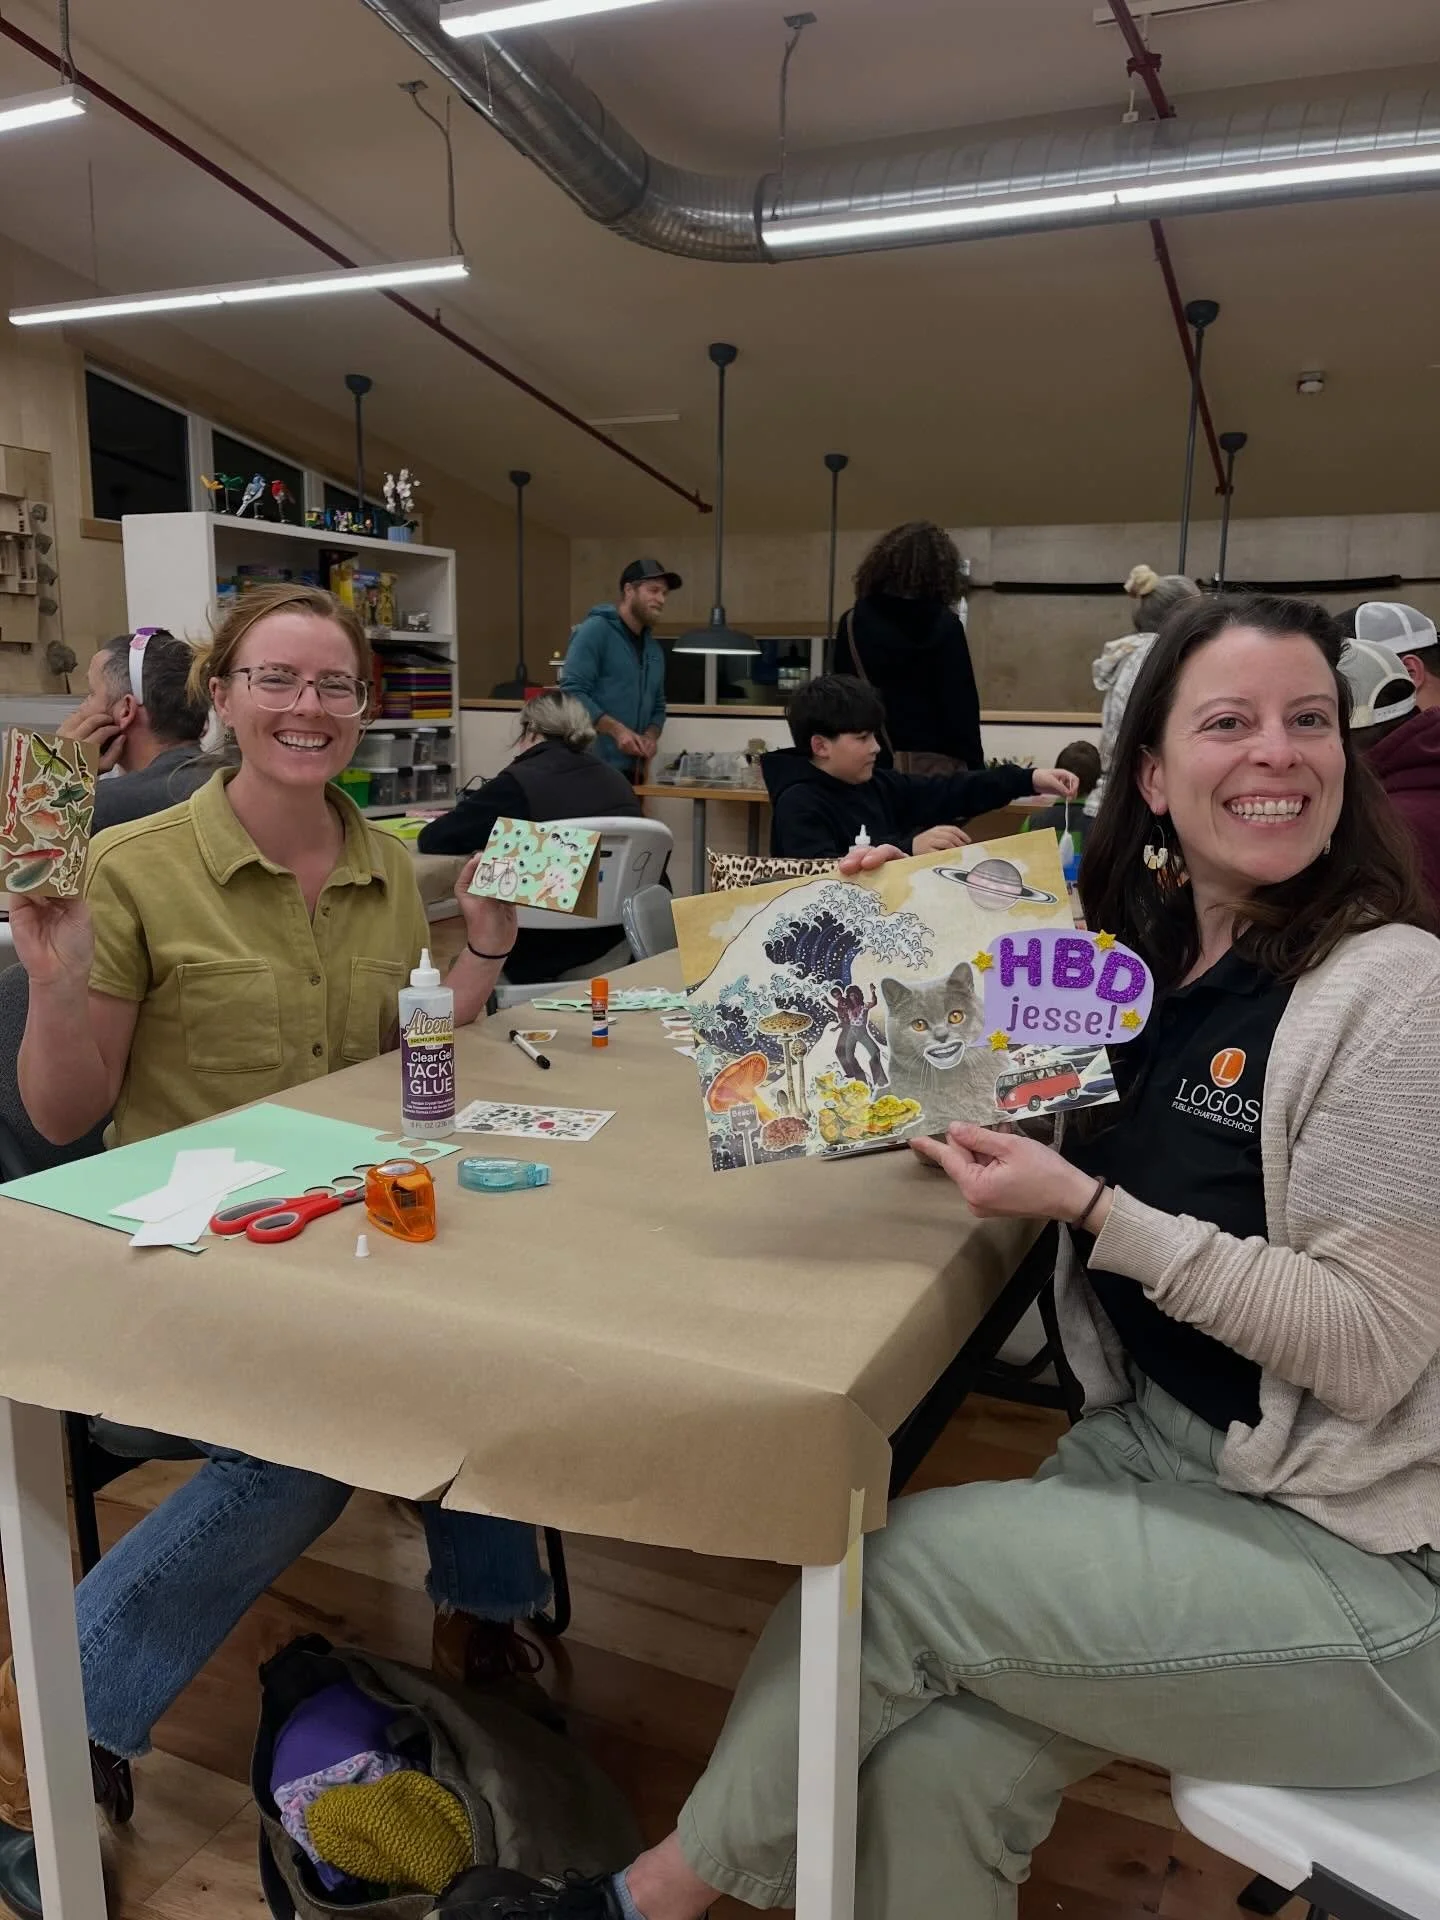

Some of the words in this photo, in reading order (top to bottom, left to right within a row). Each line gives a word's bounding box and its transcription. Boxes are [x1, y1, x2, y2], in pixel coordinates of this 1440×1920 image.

[1000, 937, 1146, 1004] HBD
[1006, 996, 1118, 1039] jesse!
[406, 1060, 454, 1079] TACKY
[410, 1050, 439, 1063] Clear
[438, 1048, 452, 1061] Gel
[1215, 1051, 1234, 1083] L
[410, 1076, 453, 1095] GLUE
[1174, 1078, 1261, 1123] LOGOS
[1171, 1100, 1194, 1114] PUBLIC
[1192, 1107, 1223, 1124] CHARTER
[1222, 1117, 1255, 1133] SCHOOL
